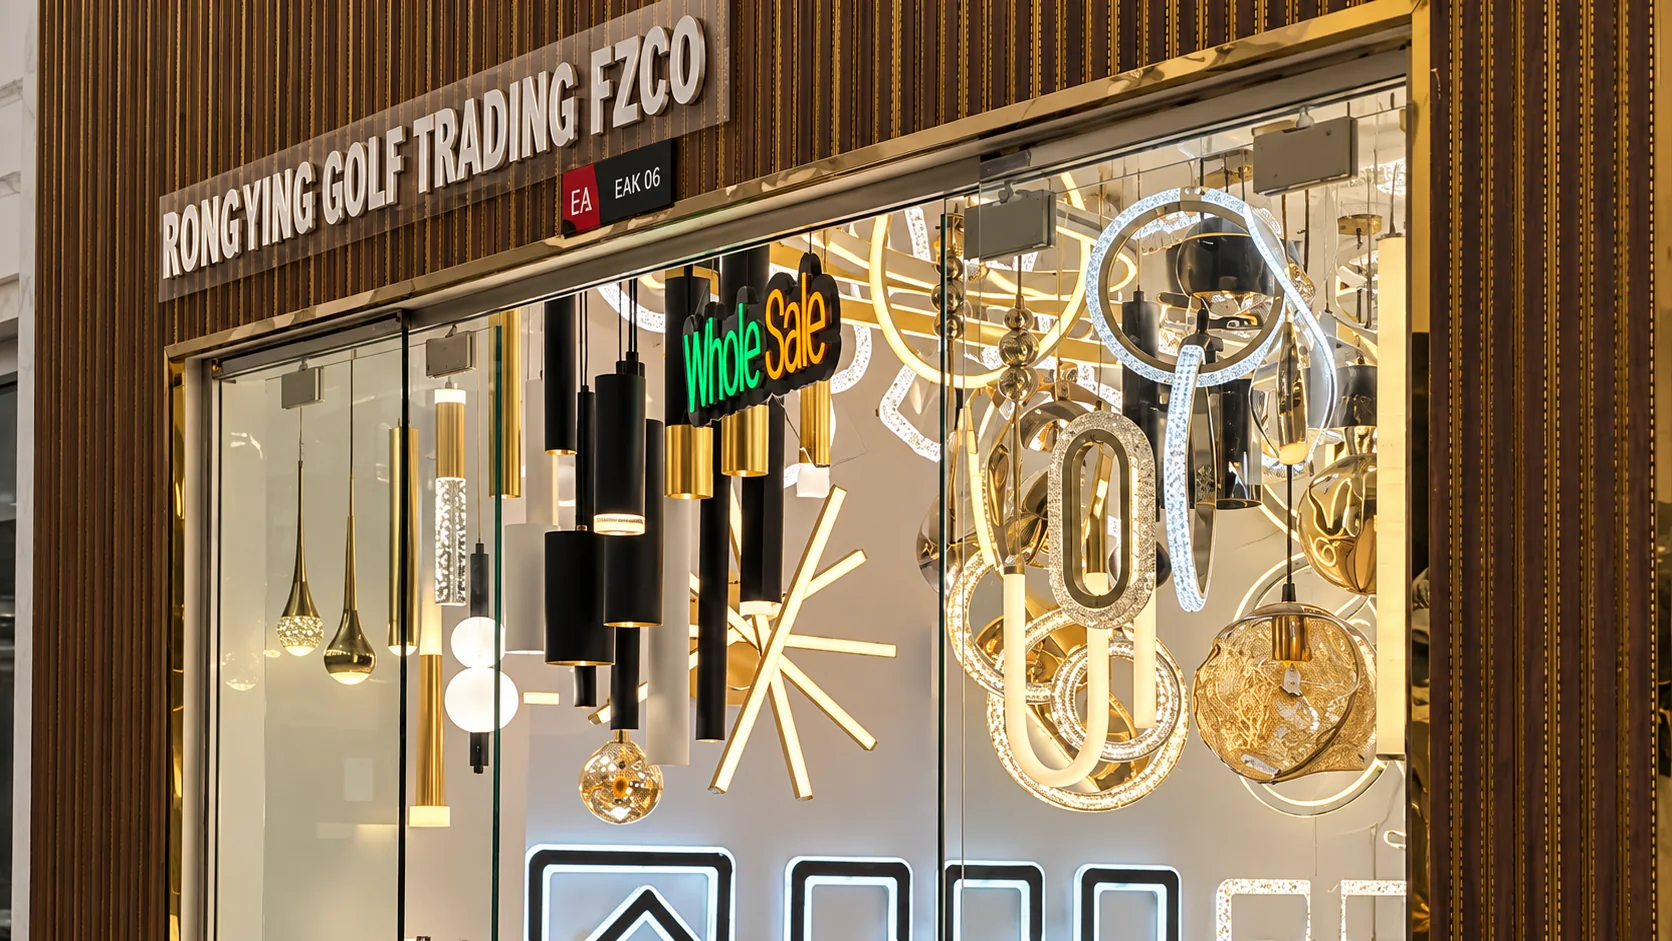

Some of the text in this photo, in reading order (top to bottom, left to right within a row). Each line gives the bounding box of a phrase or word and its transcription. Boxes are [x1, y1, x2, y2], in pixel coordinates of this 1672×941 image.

[322, 125, 406, 226] GOLF
[413, 62, 578, 195] TRADING
[590, 15, 706, 136] FZCO
[571, 186, 592, 216] EA
[615, 166, 660, 199] EAK 06
[684, 272, 826, 413] Whole Sale
